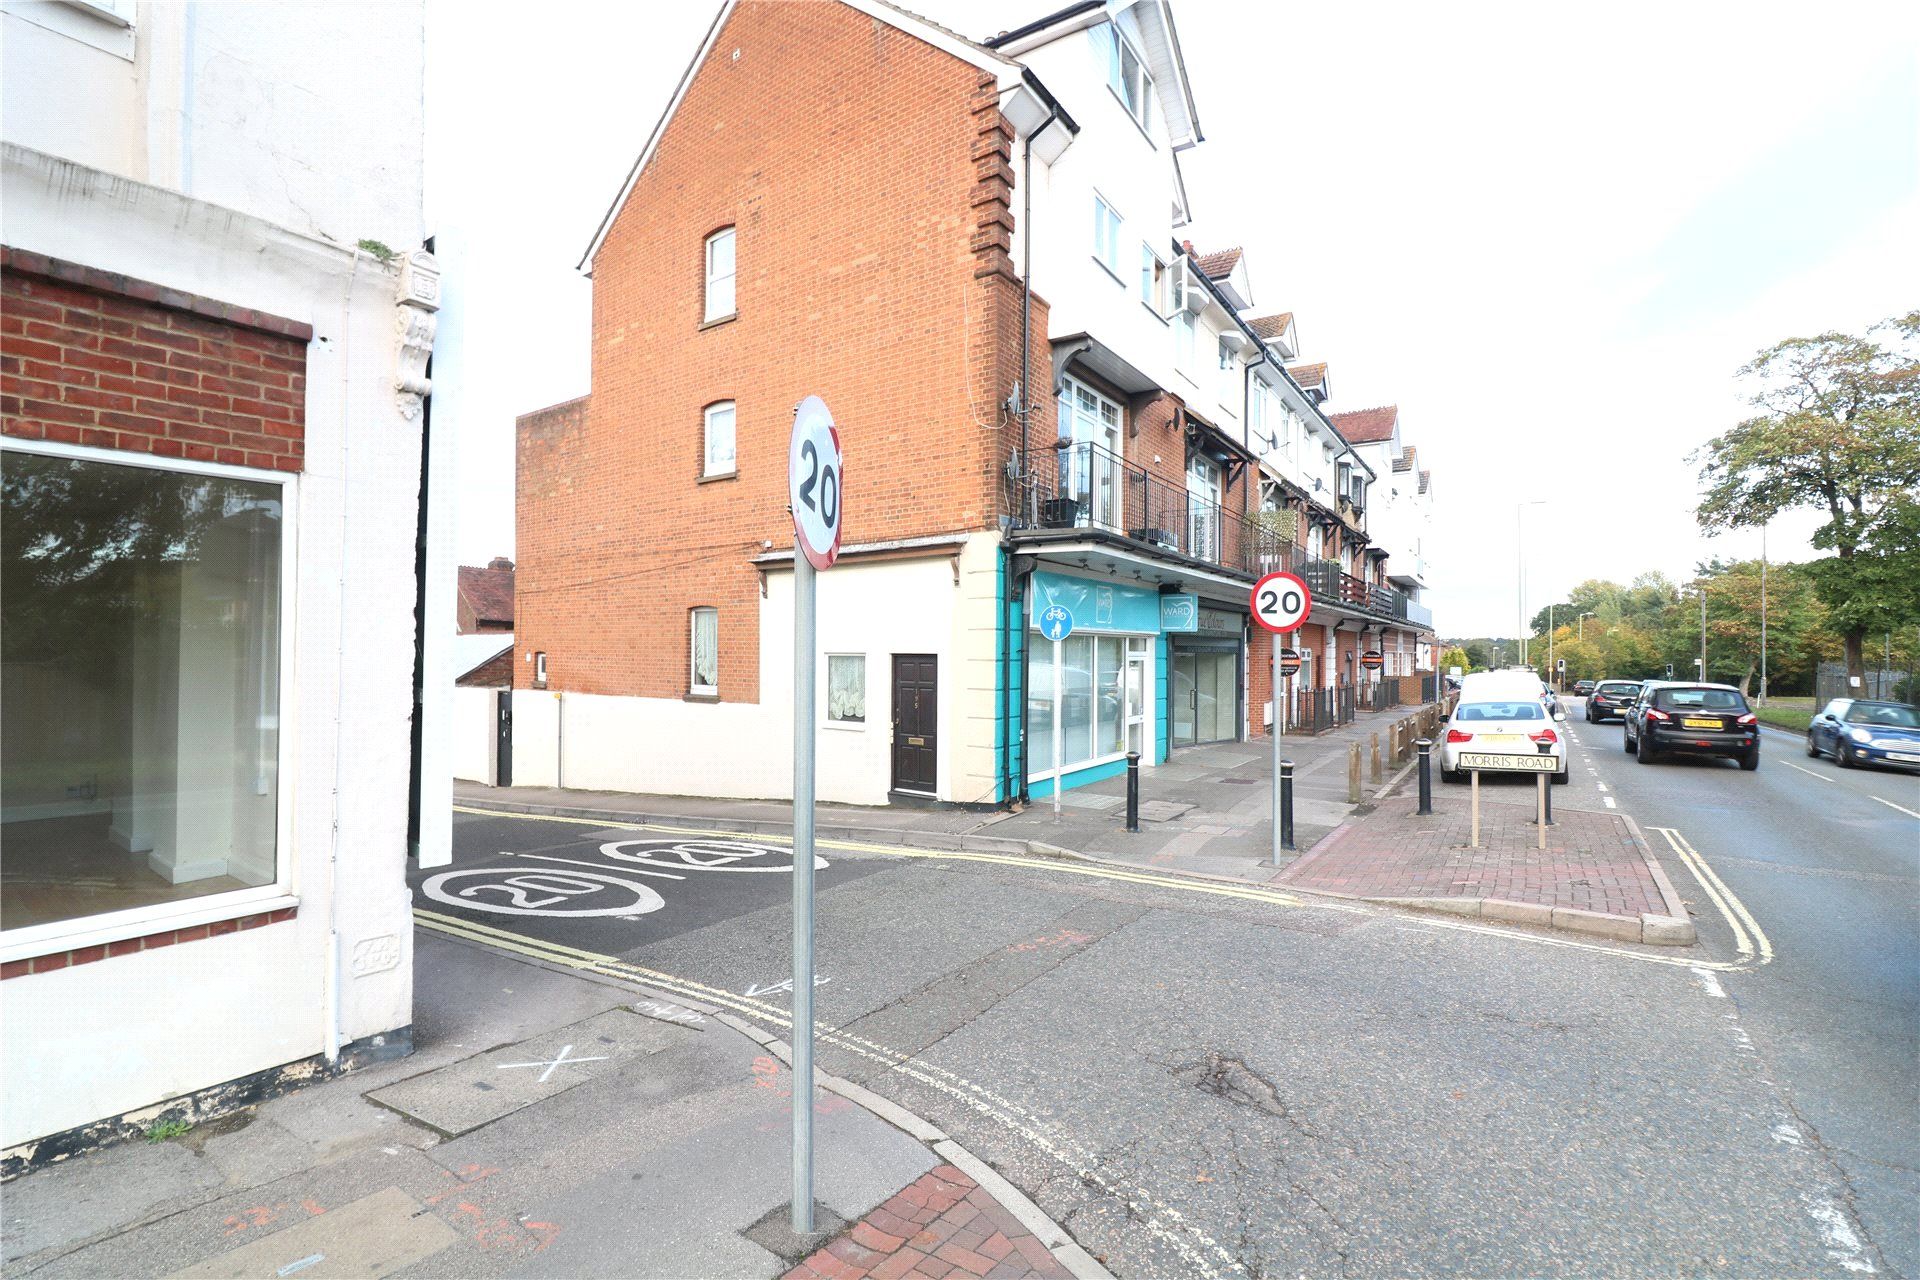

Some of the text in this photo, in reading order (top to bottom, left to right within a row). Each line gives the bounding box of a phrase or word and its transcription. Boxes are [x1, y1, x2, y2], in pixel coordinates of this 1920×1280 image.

[798, 438, 837, 529] 20
[1163, 607, 1191, 616] WARD
[1260, 590, 1301, 615] 20
[1463, 755, 1554, 769] MORRIS ROAD
[635, 844, 768, 867] 20
[459, 875, 605, 909] 20
